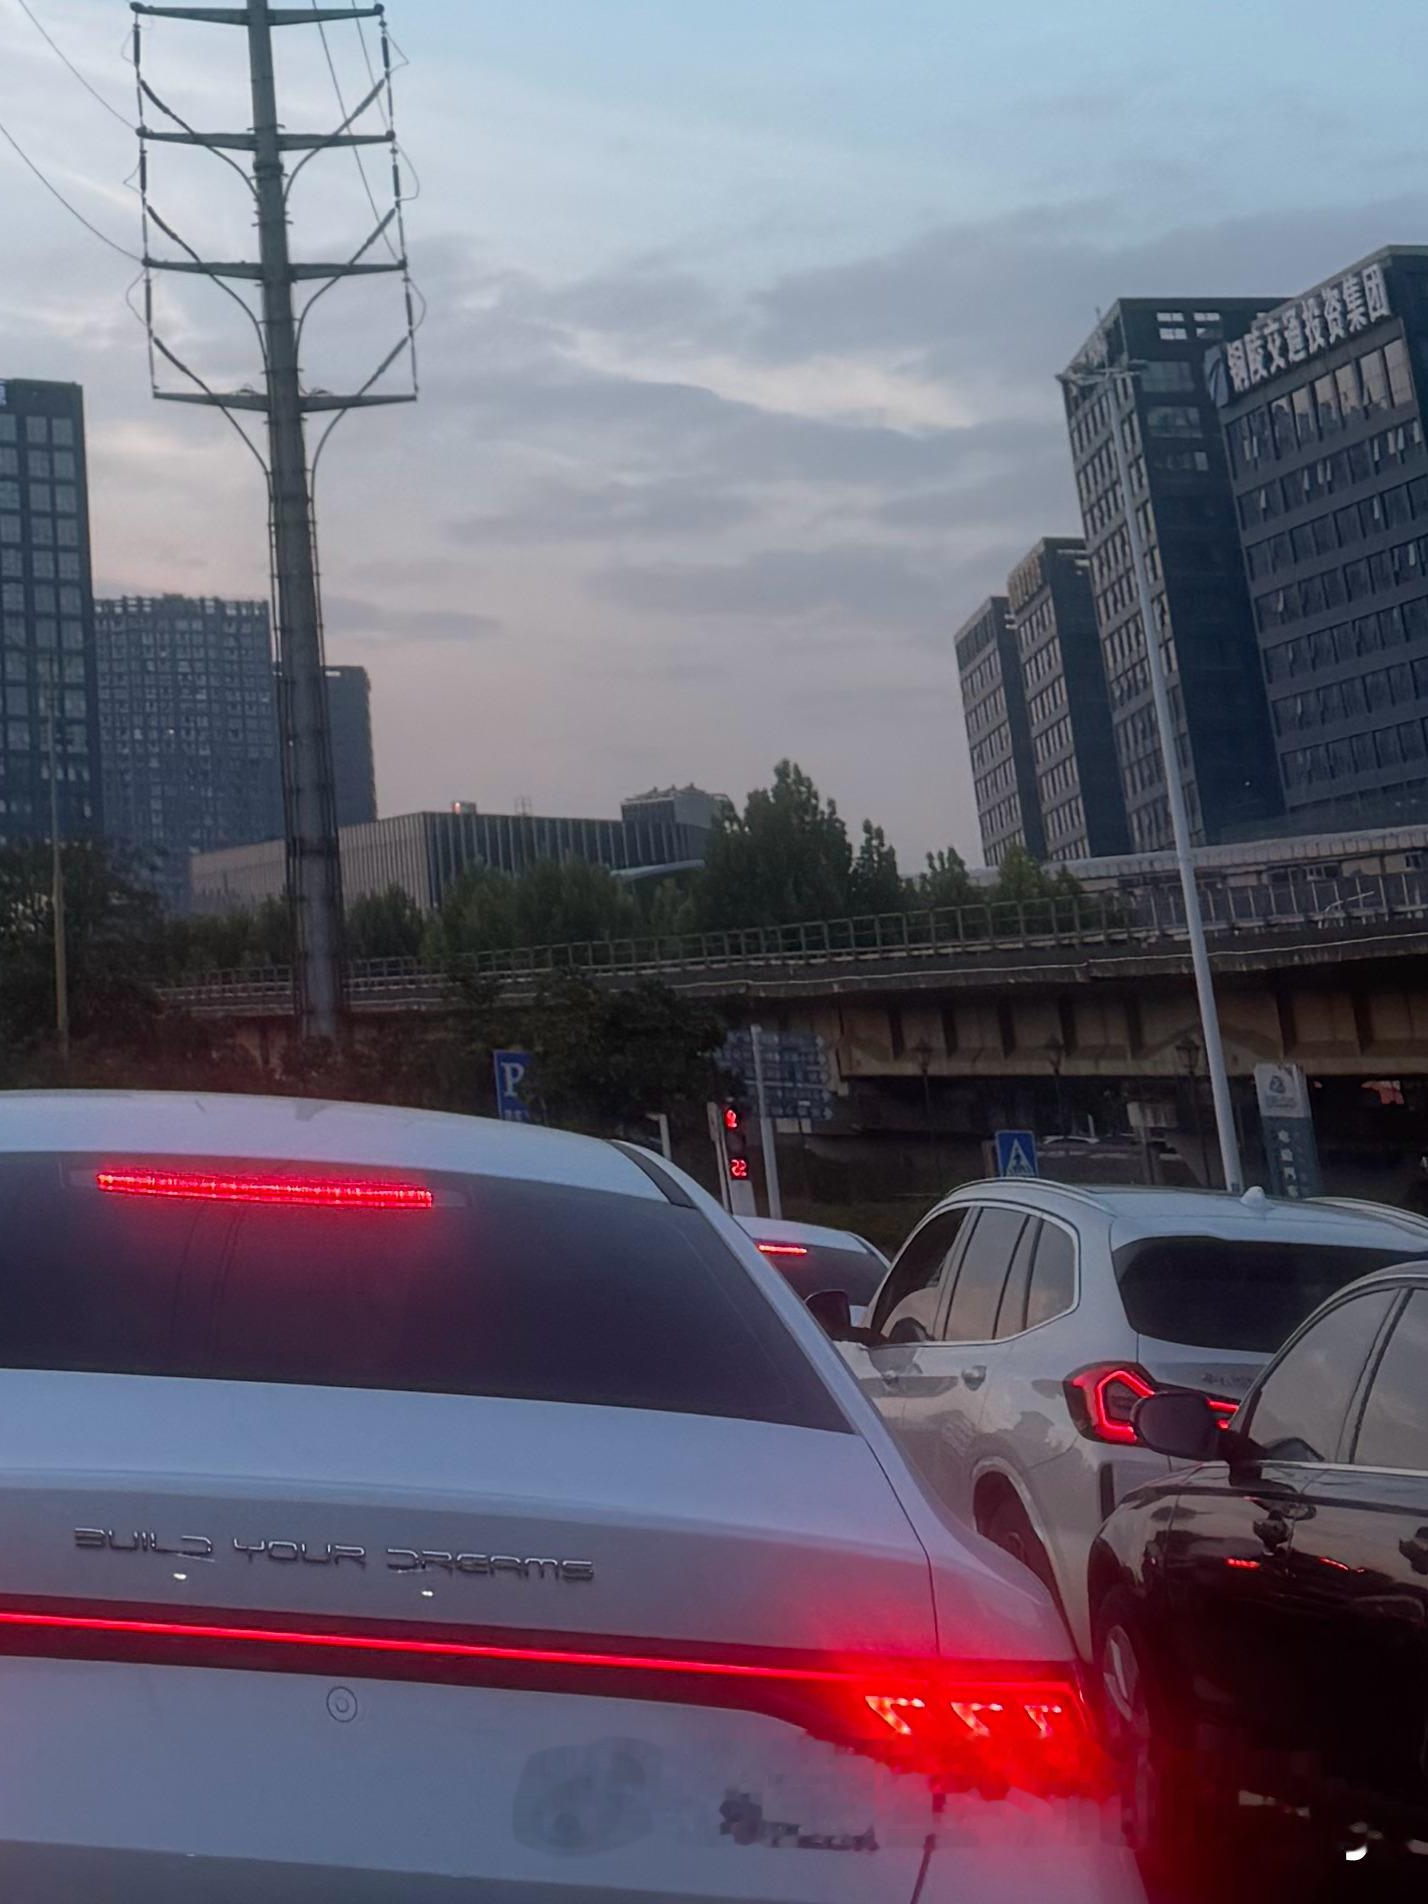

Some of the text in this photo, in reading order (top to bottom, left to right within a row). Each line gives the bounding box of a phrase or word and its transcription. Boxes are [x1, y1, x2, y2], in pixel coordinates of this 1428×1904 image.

[500, 1061, 525, 1097] P
[73, 1527, 594, 1581] BUILD YOUR DREAMS
